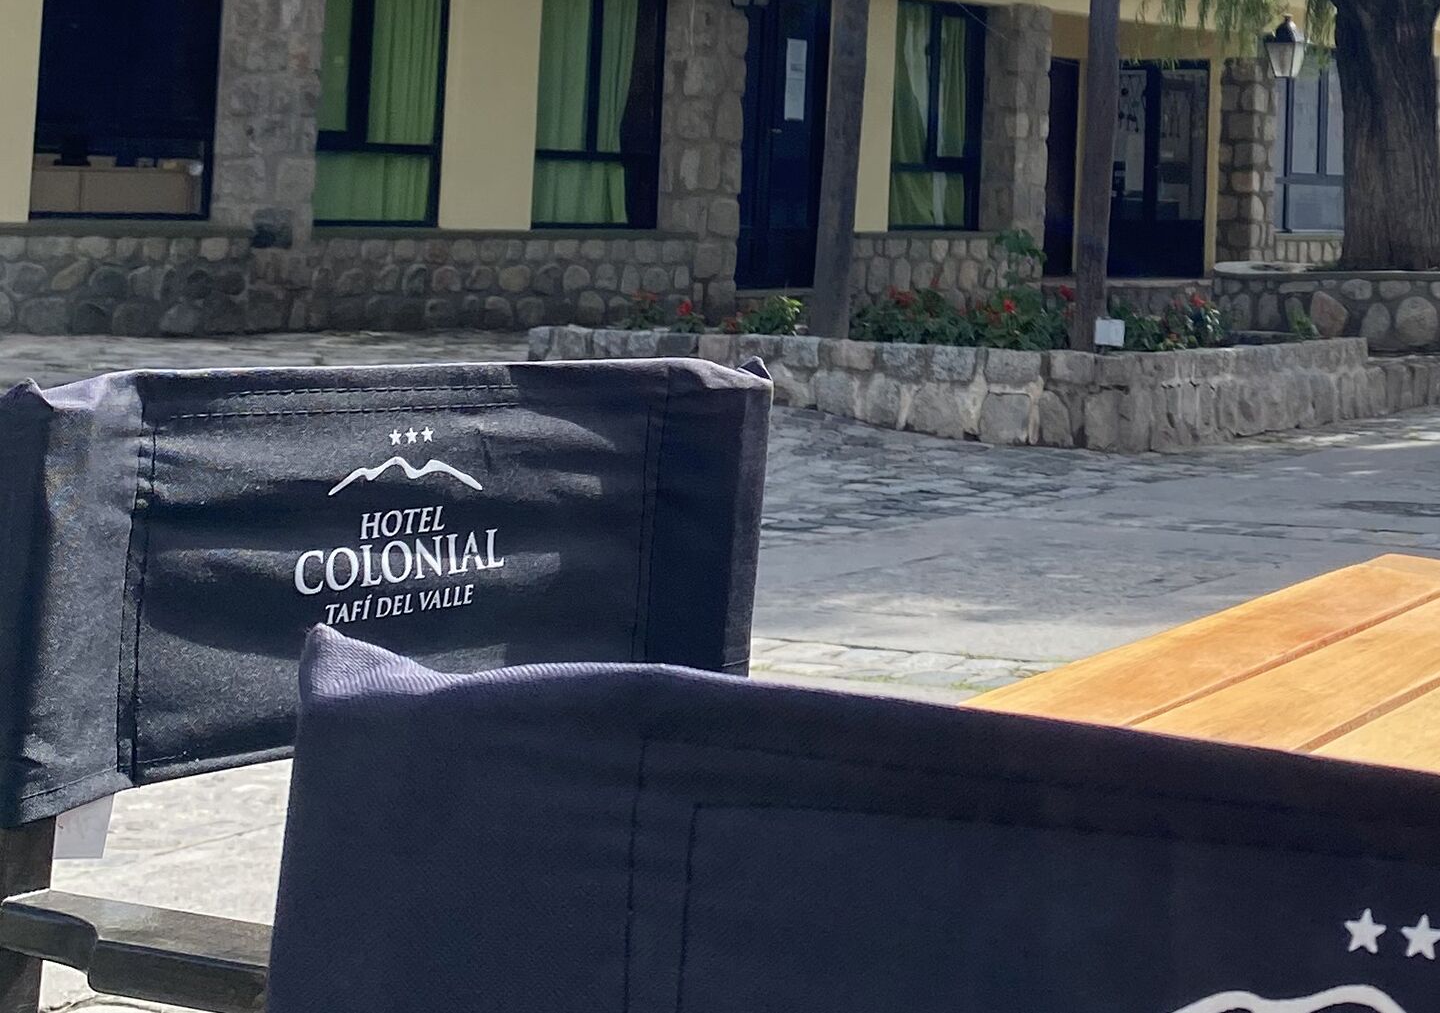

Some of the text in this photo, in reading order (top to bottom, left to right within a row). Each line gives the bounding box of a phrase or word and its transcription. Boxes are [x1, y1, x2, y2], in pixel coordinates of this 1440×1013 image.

[360, 505, 446, 540] HOTEL
[294, 528, 505, 595] COLONIAL
[325, 584, 475, 626] TAFÍ DEL VALLE
